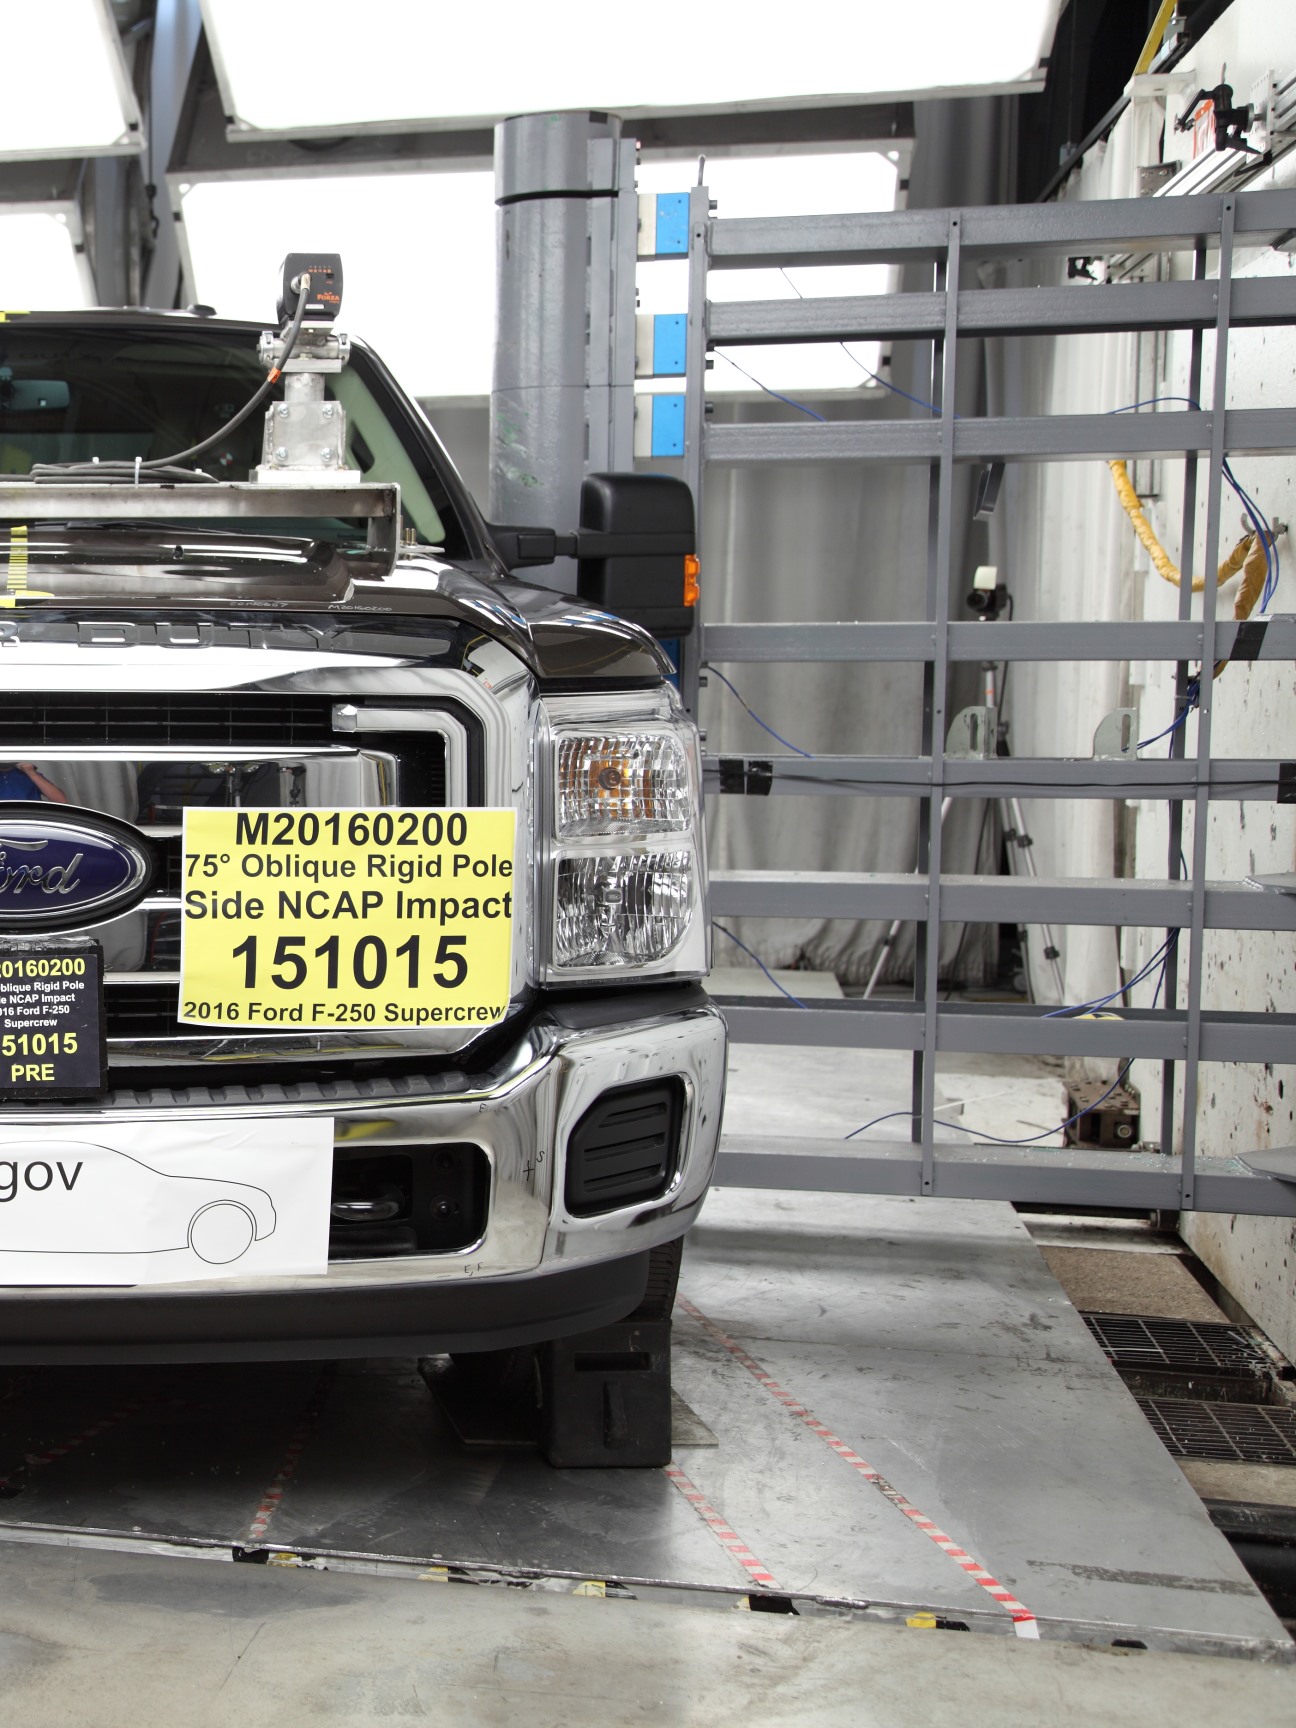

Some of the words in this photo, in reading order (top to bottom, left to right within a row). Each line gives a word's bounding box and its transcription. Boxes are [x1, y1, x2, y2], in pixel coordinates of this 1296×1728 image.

[235, 812, 468, 847] M20160200
[241, 854, 356, 883] Oblique
[367, 854, 442, 883] Rigid
[453, 854, 513, 878] Pole
[185, 890, 264, 920] Side
[278, 890, 384, 920] NCAP
[396, 890, 512, 926] Impact
[232, 934, 468, 990] 151015
[33, 981, 60, 993] Rigid
[62, 980, 85, 990] Pole
[9, 994, 39, 1004] NCAP
[41, 993, 76, 1004] Impact
[16, 1006, 41, 1016] Ford
[42, 1005, 70, 1015] F-250
[183, 1001, 240, 1020] 2016
[248, 1002, 303, 1021] Ford
[312, 1003, 376, 1022] F-250
[384, 1003, 505, 1026] Supercrew
[4, 1018, 58, 1029] Supercrew
[11, 1063, 55, 1082] PRE
